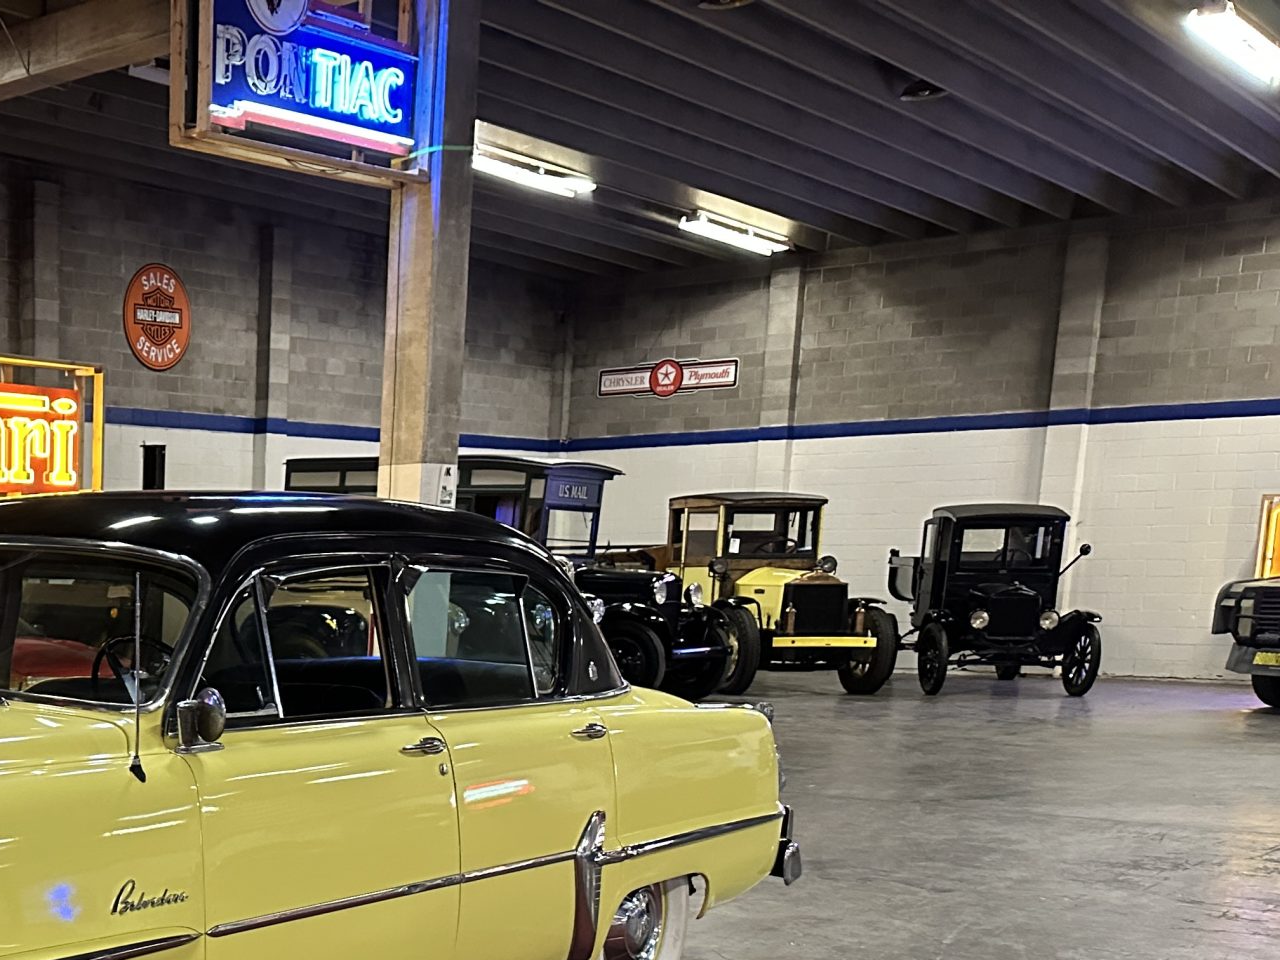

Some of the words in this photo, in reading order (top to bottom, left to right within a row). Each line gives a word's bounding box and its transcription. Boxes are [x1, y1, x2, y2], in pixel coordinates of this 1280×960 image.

[215, 23, 405, 124] PONTIAC
[141, 272, 176, 293] SALES
[136, 336, 181, 363] SERVICE
[603, 376, 645, 388] CHRYSLER
[688, 367, 731, 384] Plymouth
[571, 485, 588, 500] MAIL
